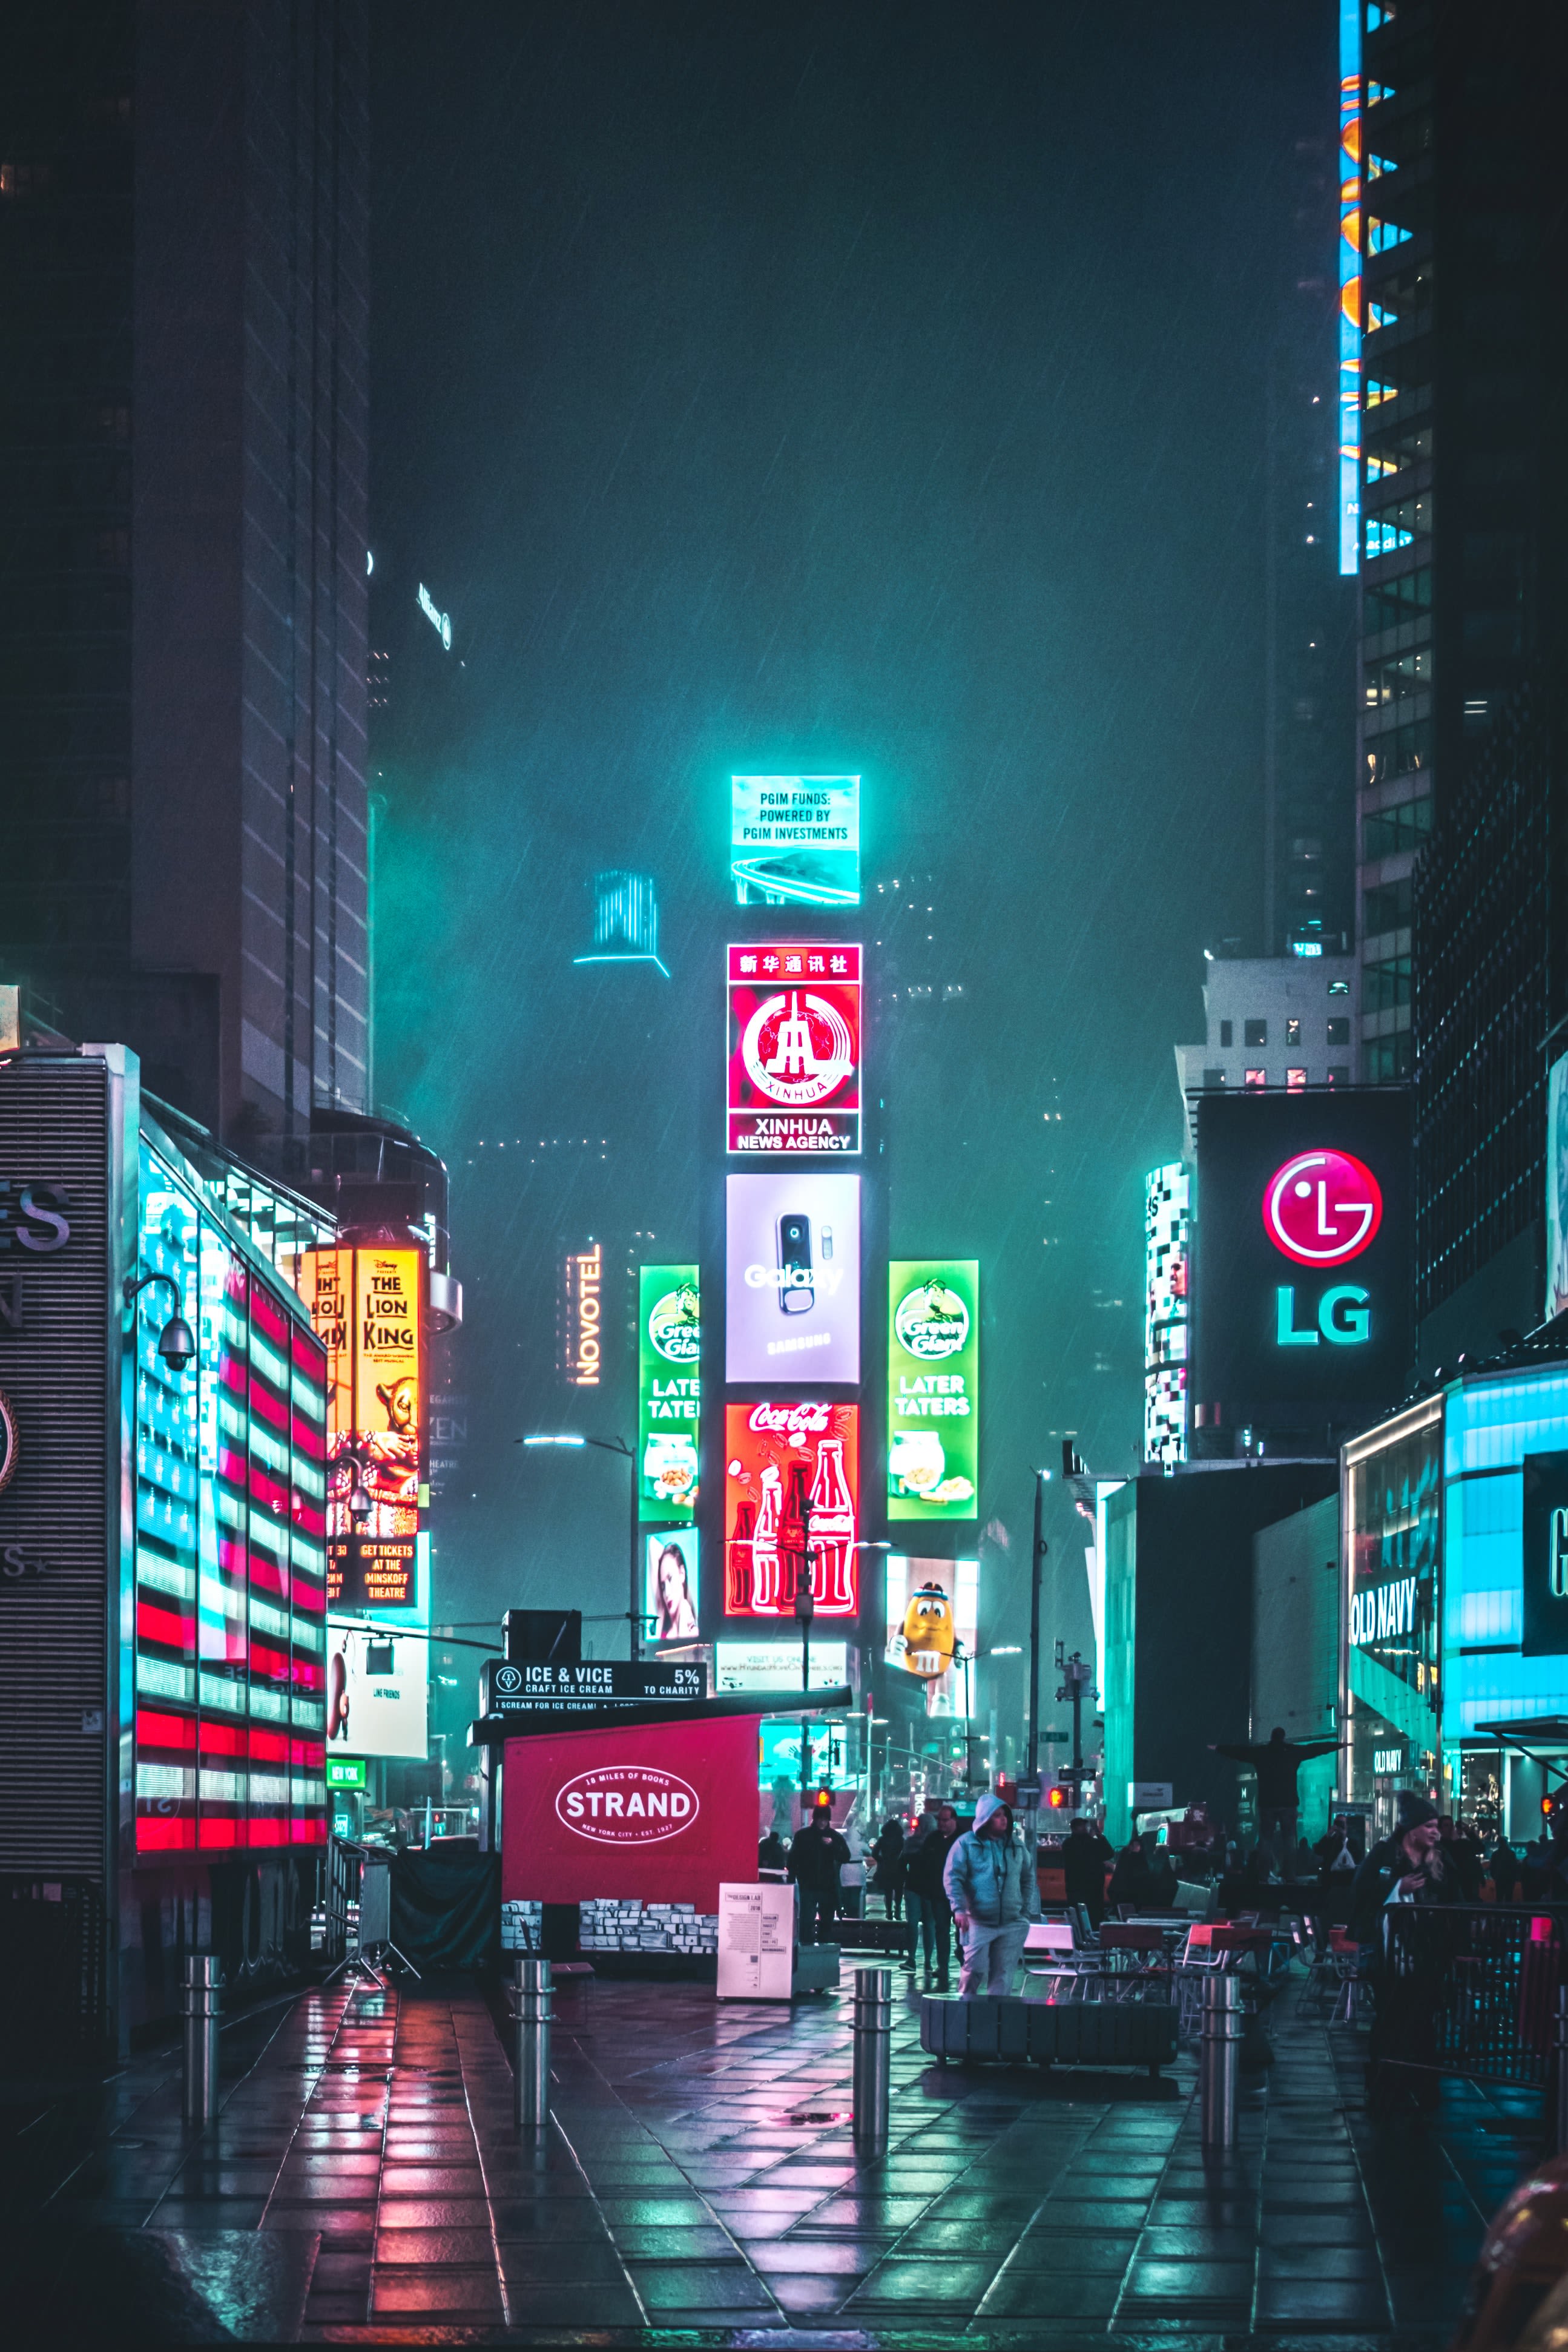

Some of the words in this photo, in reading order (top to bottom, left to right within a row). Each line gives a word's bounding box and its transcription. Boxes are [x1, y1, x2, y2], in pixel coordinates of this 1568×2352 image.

[760, 792, 788, 805] PGIM
[792, 792, 831, 805] FUNDS:
[760, 810, 812, 822] POWERED
[816, 810, 831, 822] BY
[743, 828, 771, 840] PGIM
[775, 828, 848, 840] INVESTMENTS
[740, 955, 848, 973] 新华通讯社
[766, 1081, 828, 1101] XINHUA
[755, 1119, 834, 1136] XINHUA
[738, 1136, 783, 1150] NEWS
[785, 1136, 851, 1150] AGENCY
[374, 1259, 398, 1271] Disney
[371, 1276, 401, 1291] THE
[744, 1263, 844, 1296] Galaxy
[366, 1294, 408, 1319] LION
[576, 1244, 601, 1385] NOVOTEL
[1277, 1285, 1371, 1345] LG
[363, 1321, 414, 1350] KING
[904, 1319, 964, 1336] Green
[767, 1332, 832, 1356] SAMSUNG
[911, 1334, 966, 1352] Giant
[899, 1375, 964, 1394] LATER
[647, 1400, 700, 1418] TATE
[894, 1397, 971, 1416] TATERS
[361, 1544, 378, 1557] GET
[378, 1544, 413, 1558] TICKETS
[372, 1559, 383, 1570] AT
[385, 1559, 401, 1570] THE
[364, 1573, 409, 1584] MINSKOFF
[369, 1587, 406, 1599] THEATRE
[1351, 1591, 1375, 1645] OLD
[1377, 1576, 1416, 1640] NAVY
[525, 1667, 552, 1682] ICE
[558, 1667, 570, 1682] &
[575, 1667, 613, 1683] VICE
[674, 1669, 700, 1685] 5%
[525, 1684, 556, 1693] CRAFT
[560, 1685, 575, 1693] ICE
[579, 1685, 613, 1693] CREAM
[644, 1685, 656, 1695] TO
[659, 1686, 699, 1695] CHARITY
[1374, 1750, 1386, 1773] OLD
[1386, 1749, 1402, 1772] NAVY
[332, 1765, 344, 1780] NEW
[344, 1766, 358, 1781] YORK
[585, 1777, 596, 1785] 18
[599, 1772, 625, 1782] MILES
[642, 1773, 670, 1786] BOOKS
[566, 1791, 690, 1817] STRAND
[582, 1823, 596, 1832] NEW
[657, 1823, 673, 1834] 1927
